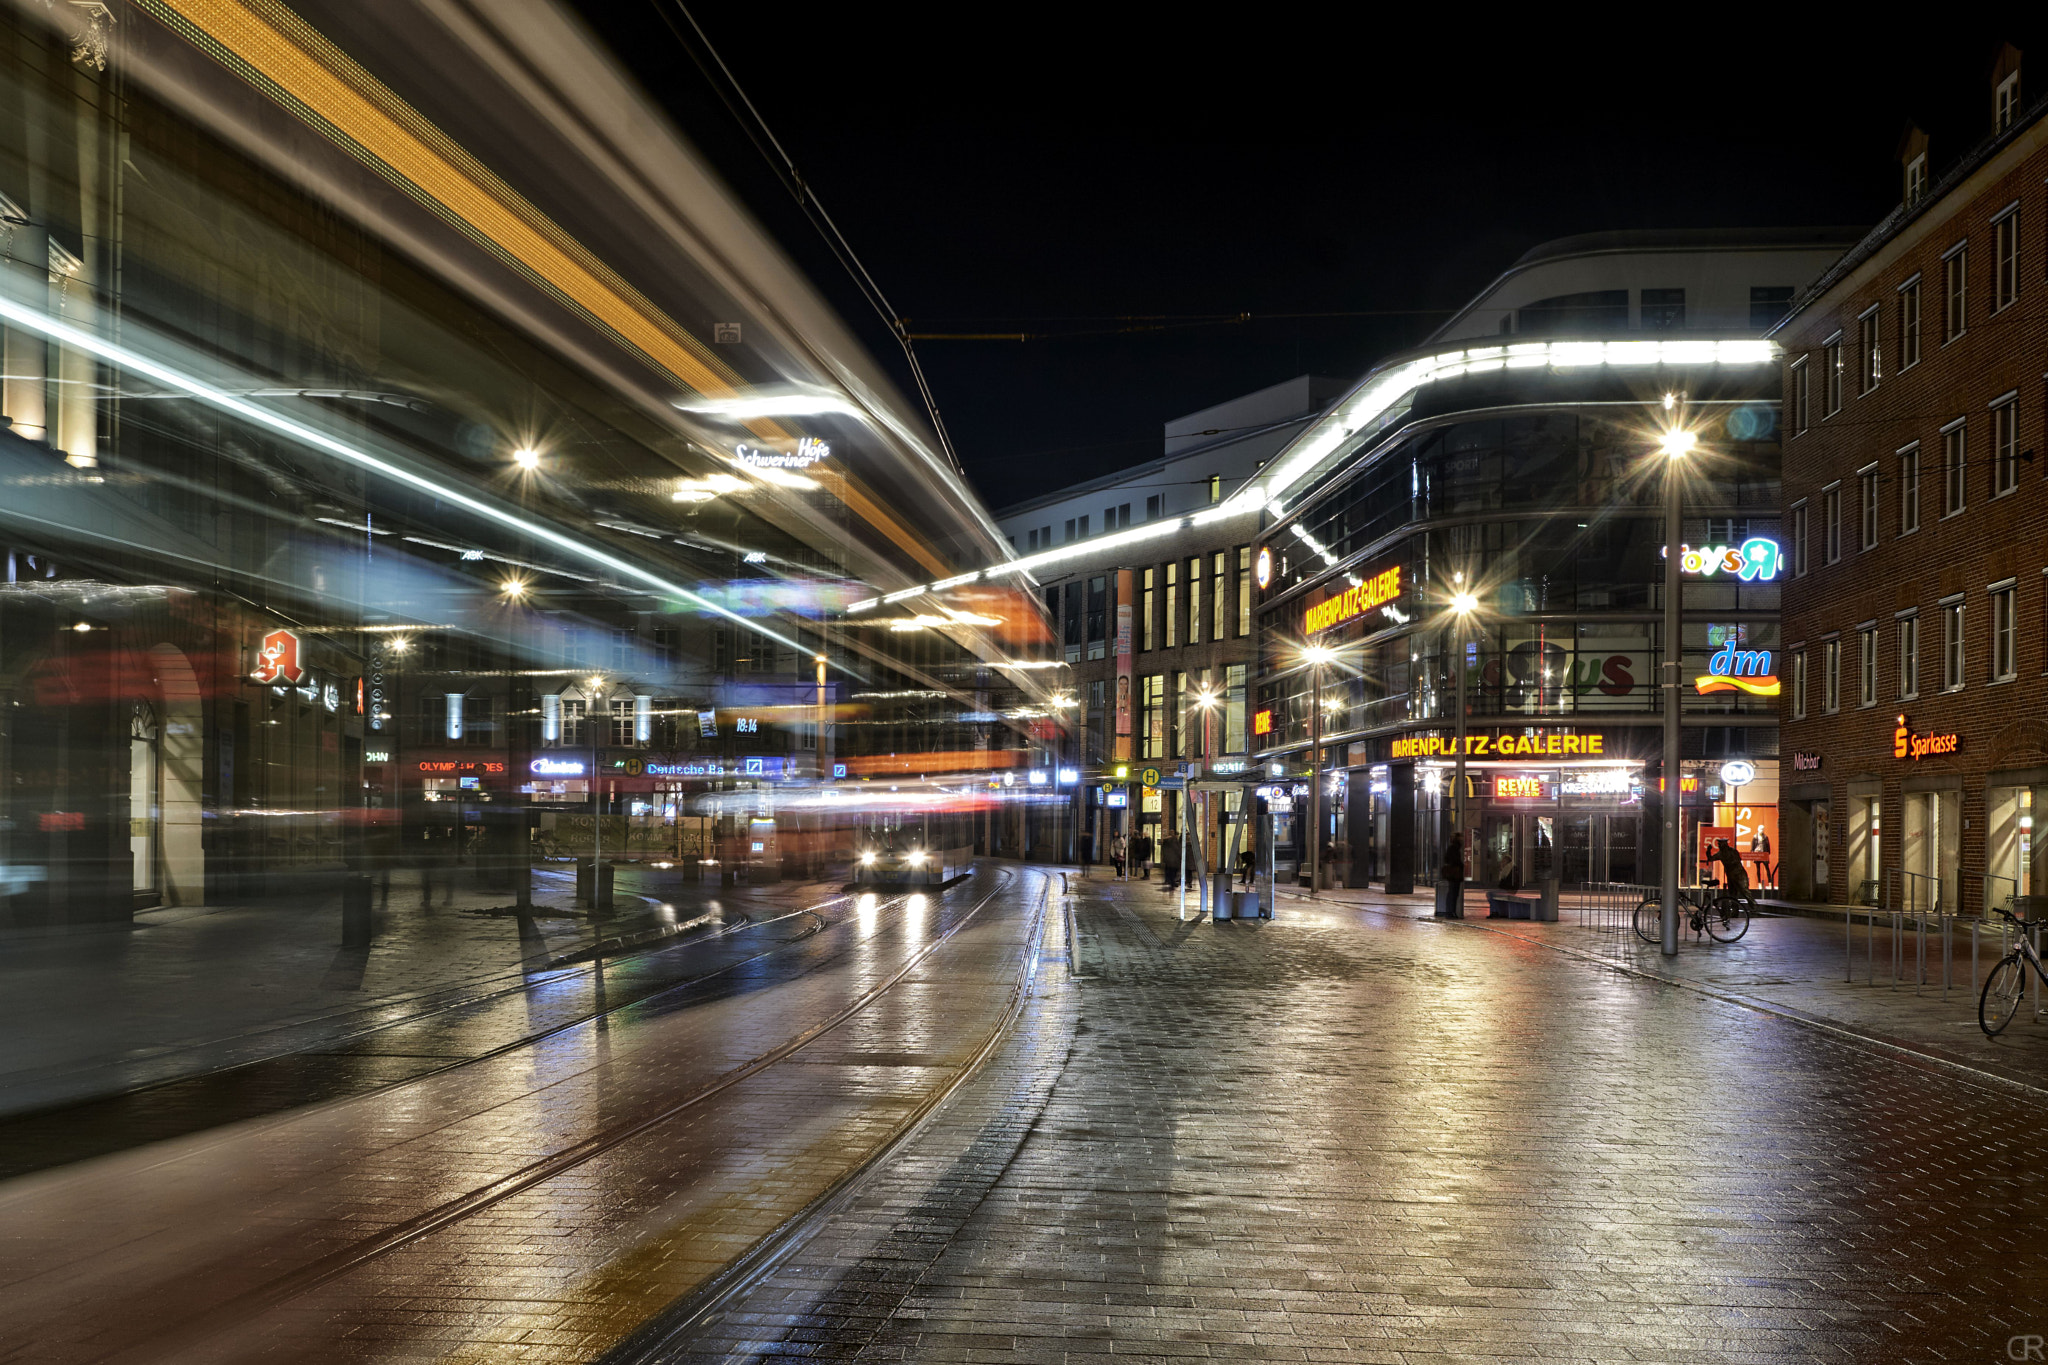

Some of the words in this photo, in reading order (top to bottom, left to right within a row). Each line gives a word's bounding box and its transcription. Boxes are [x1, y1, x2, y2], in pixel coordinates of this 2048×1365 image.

[736, 444, 814, 467] Schweriner
[461, 550, 484, 560] AOK
[743, 552, 766, 562] AOK
[1306, 565, 1401, 636] MARIENPLATZ-GALERIE
[1708, 640, 1772, 676] dm
[736, 717, 758, 733] 18:14
[1255, 710, 1271, 735] REWE
[1392, 734, 1604, 758] MARIENPLATZ-GALERIE
[1910, 731, 1957, 761] Sparkasse
[419, 761, 456, 771] OLYMP
[647, 763, 705, 775] Deutsche
[1793, 752, 1821, 771] Milchbar
[1497, 778, 1540, 792] REWE
